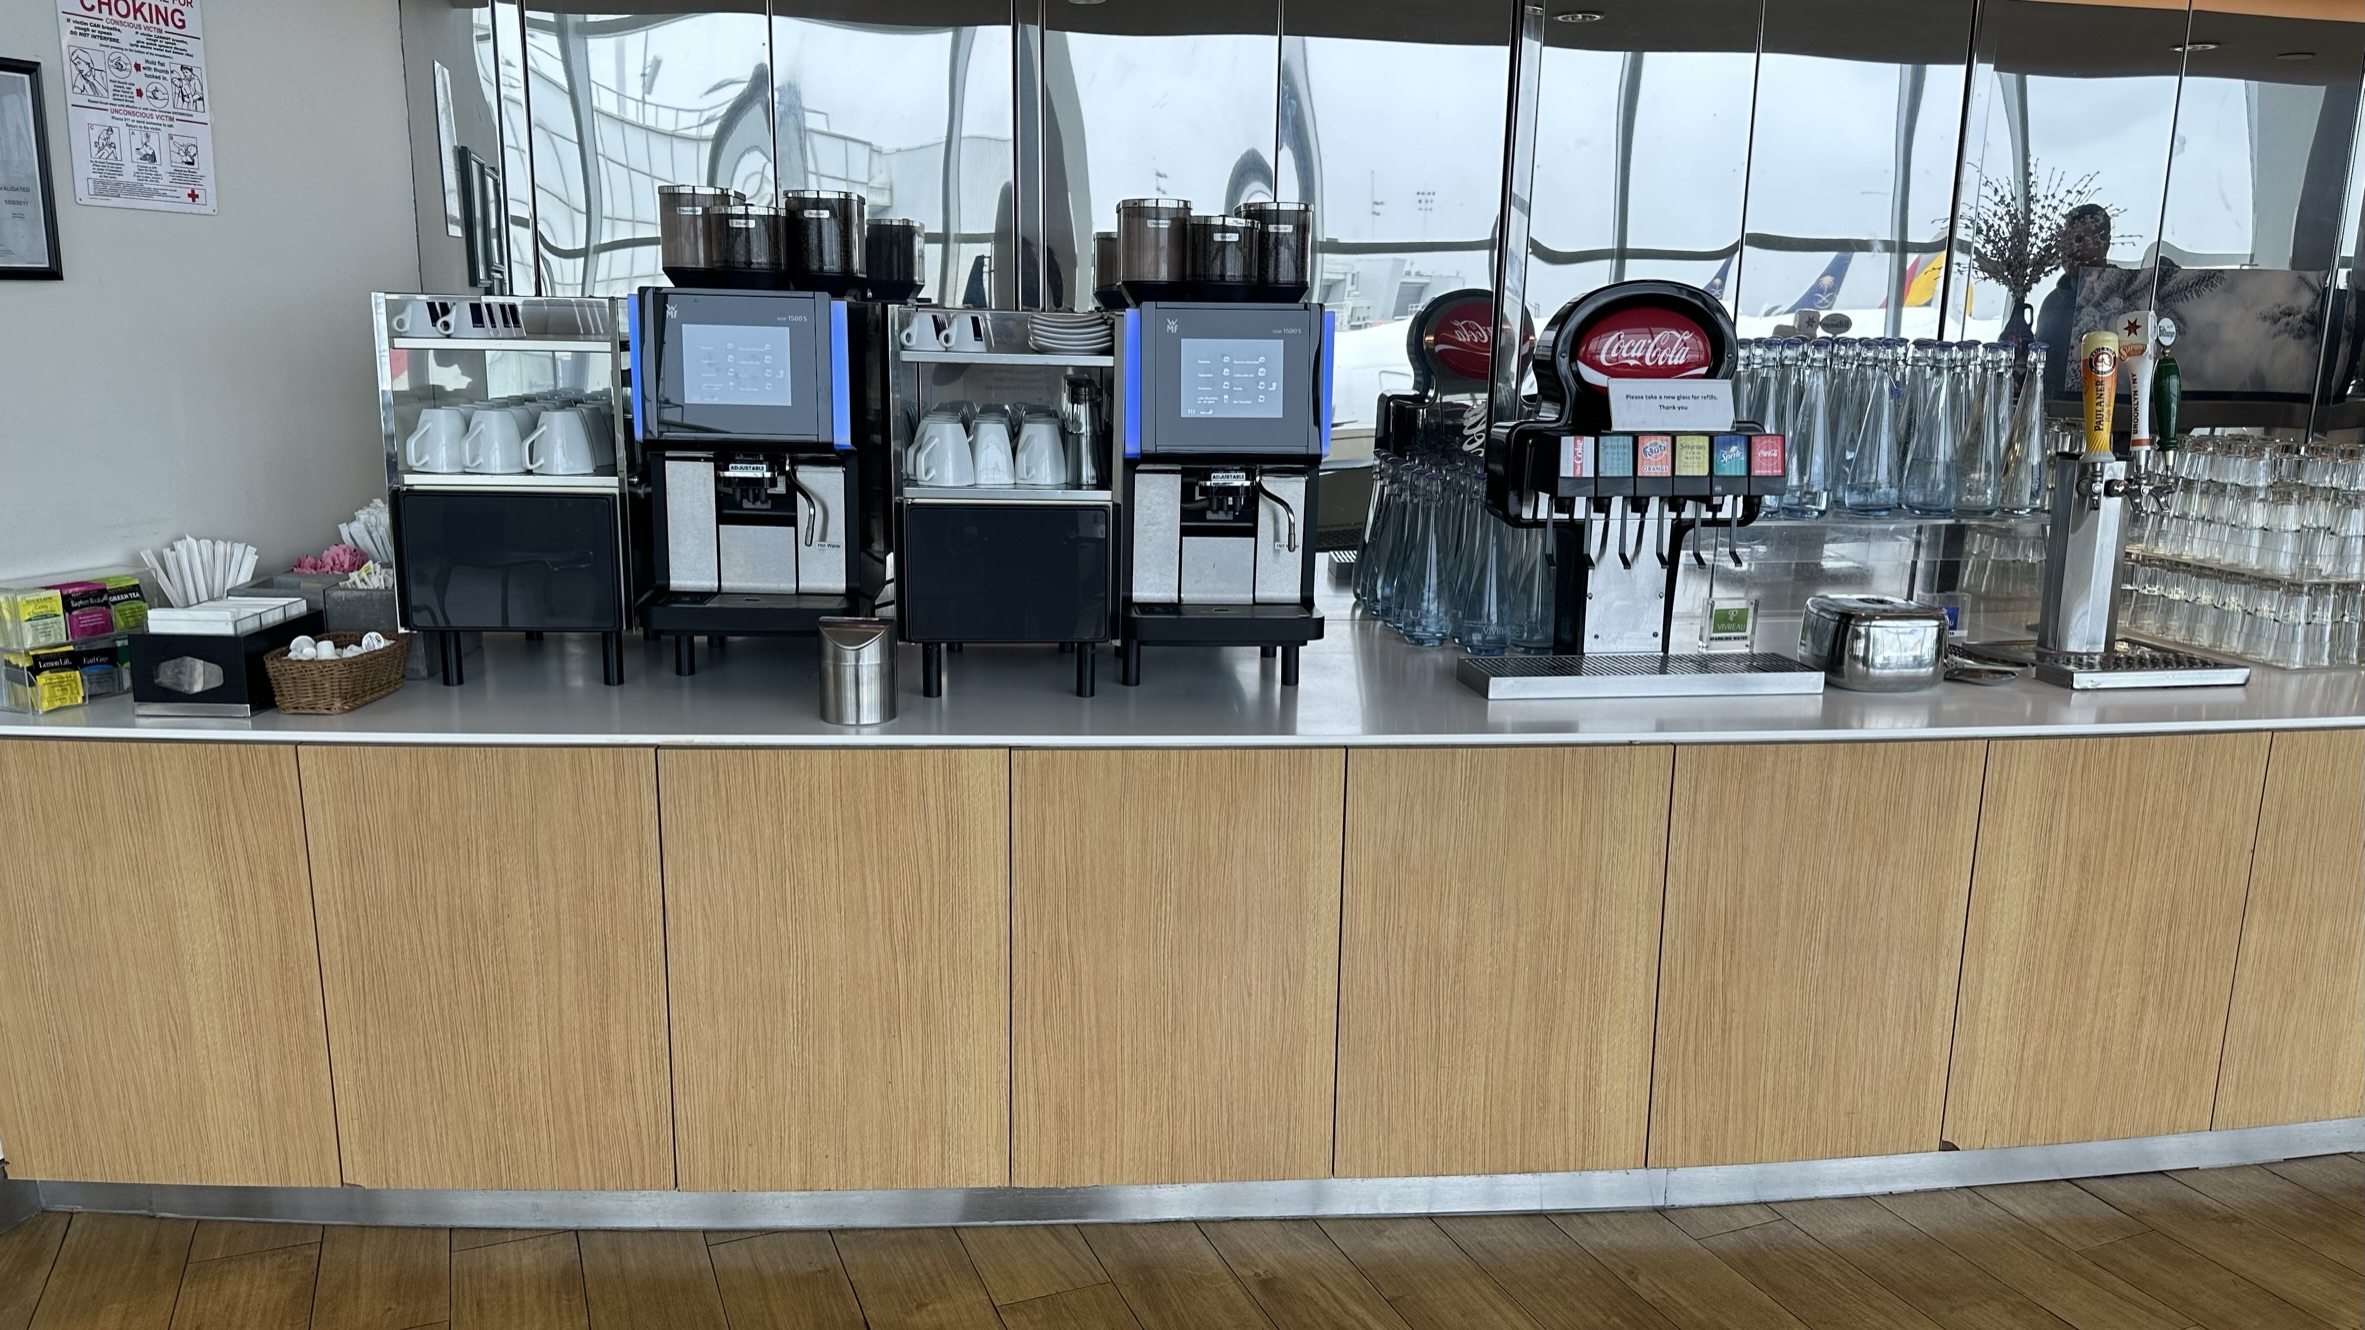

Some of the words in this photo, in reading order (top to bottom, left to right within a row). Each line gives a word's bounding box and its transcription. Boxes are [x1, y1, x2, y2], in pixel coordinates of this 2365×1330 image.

[80, 0, 187, 30] CHOKING
[105, 17, 143, 30] CONSCIOUS
[143, 25, 163, 34] VICTIM
[110, 108, 154, 120] UNCONSCIOUS
[155, 114, 175, 122] VICTIM
[1600, 330, 1695, 367] Coca-Cola
[2131, 373, 2138, 384] NY
[2094, 379, 2105, 432] PAULANER
[1574, 439, 1584, 464] Coke
[1642, 444, 1667, 459] Fanta
[1720, 450, 1744, 463] Sprite
[1758, 449, 1778, 458] Coca-Cola
[109, 594, 129, 602] GREEN
[129, 592, 140, 600] TEA
[1717, 623, 1746, 631] VIVREAU
[39, 660, 60, 668] Lemon
[83, 656, 95, 664] Earl
